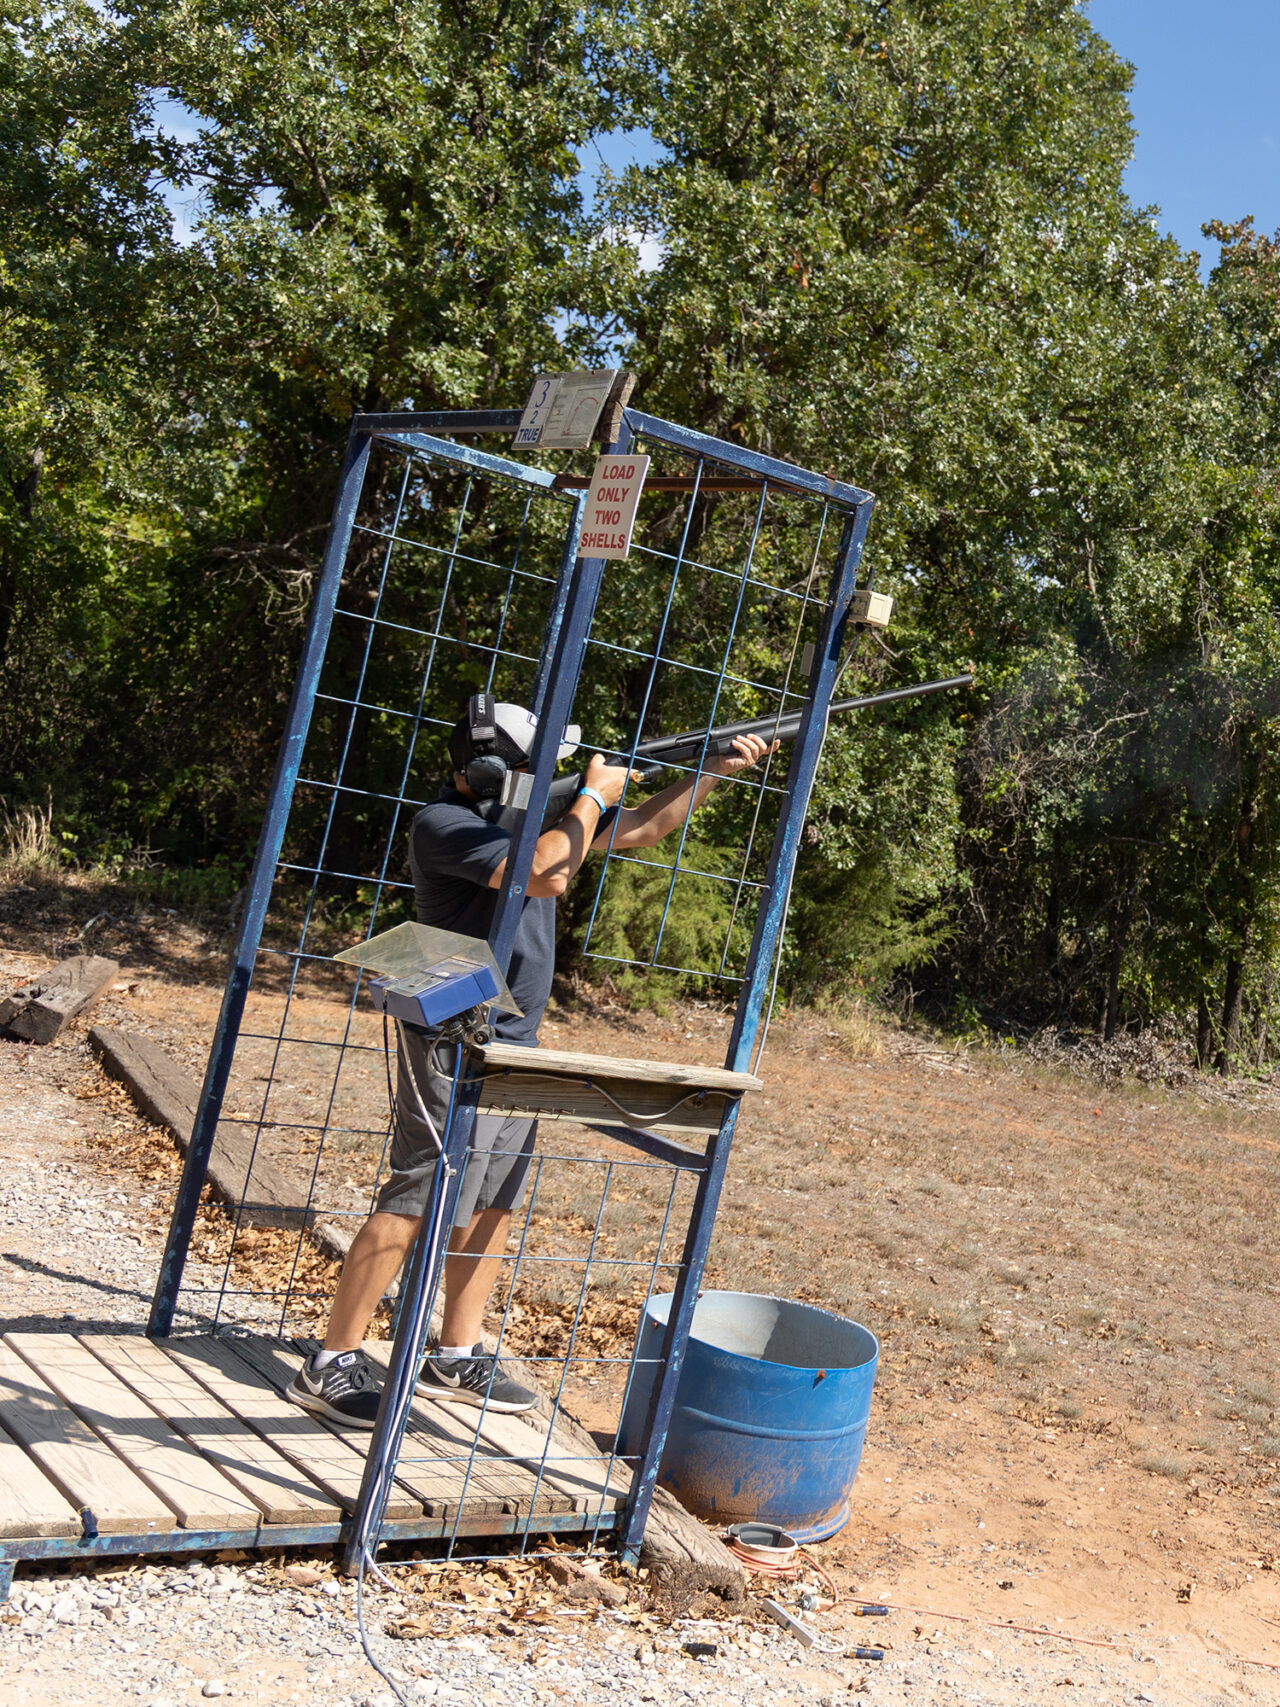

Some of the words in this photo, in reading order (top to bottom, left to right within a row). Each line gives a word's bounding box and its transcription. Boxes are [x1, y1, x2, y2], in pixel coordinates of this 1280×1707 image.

[535, 381, 550, 407] 3
[529, 410, 538, 424] 2
[518, 428, 539, 441] TRUE
[602, 465, 635, 479] LOAD
[597, 487, 630, 502] ONLY
[595, 510, 620, 525] TWO
[581, 533, 625, 549] SHELLS
